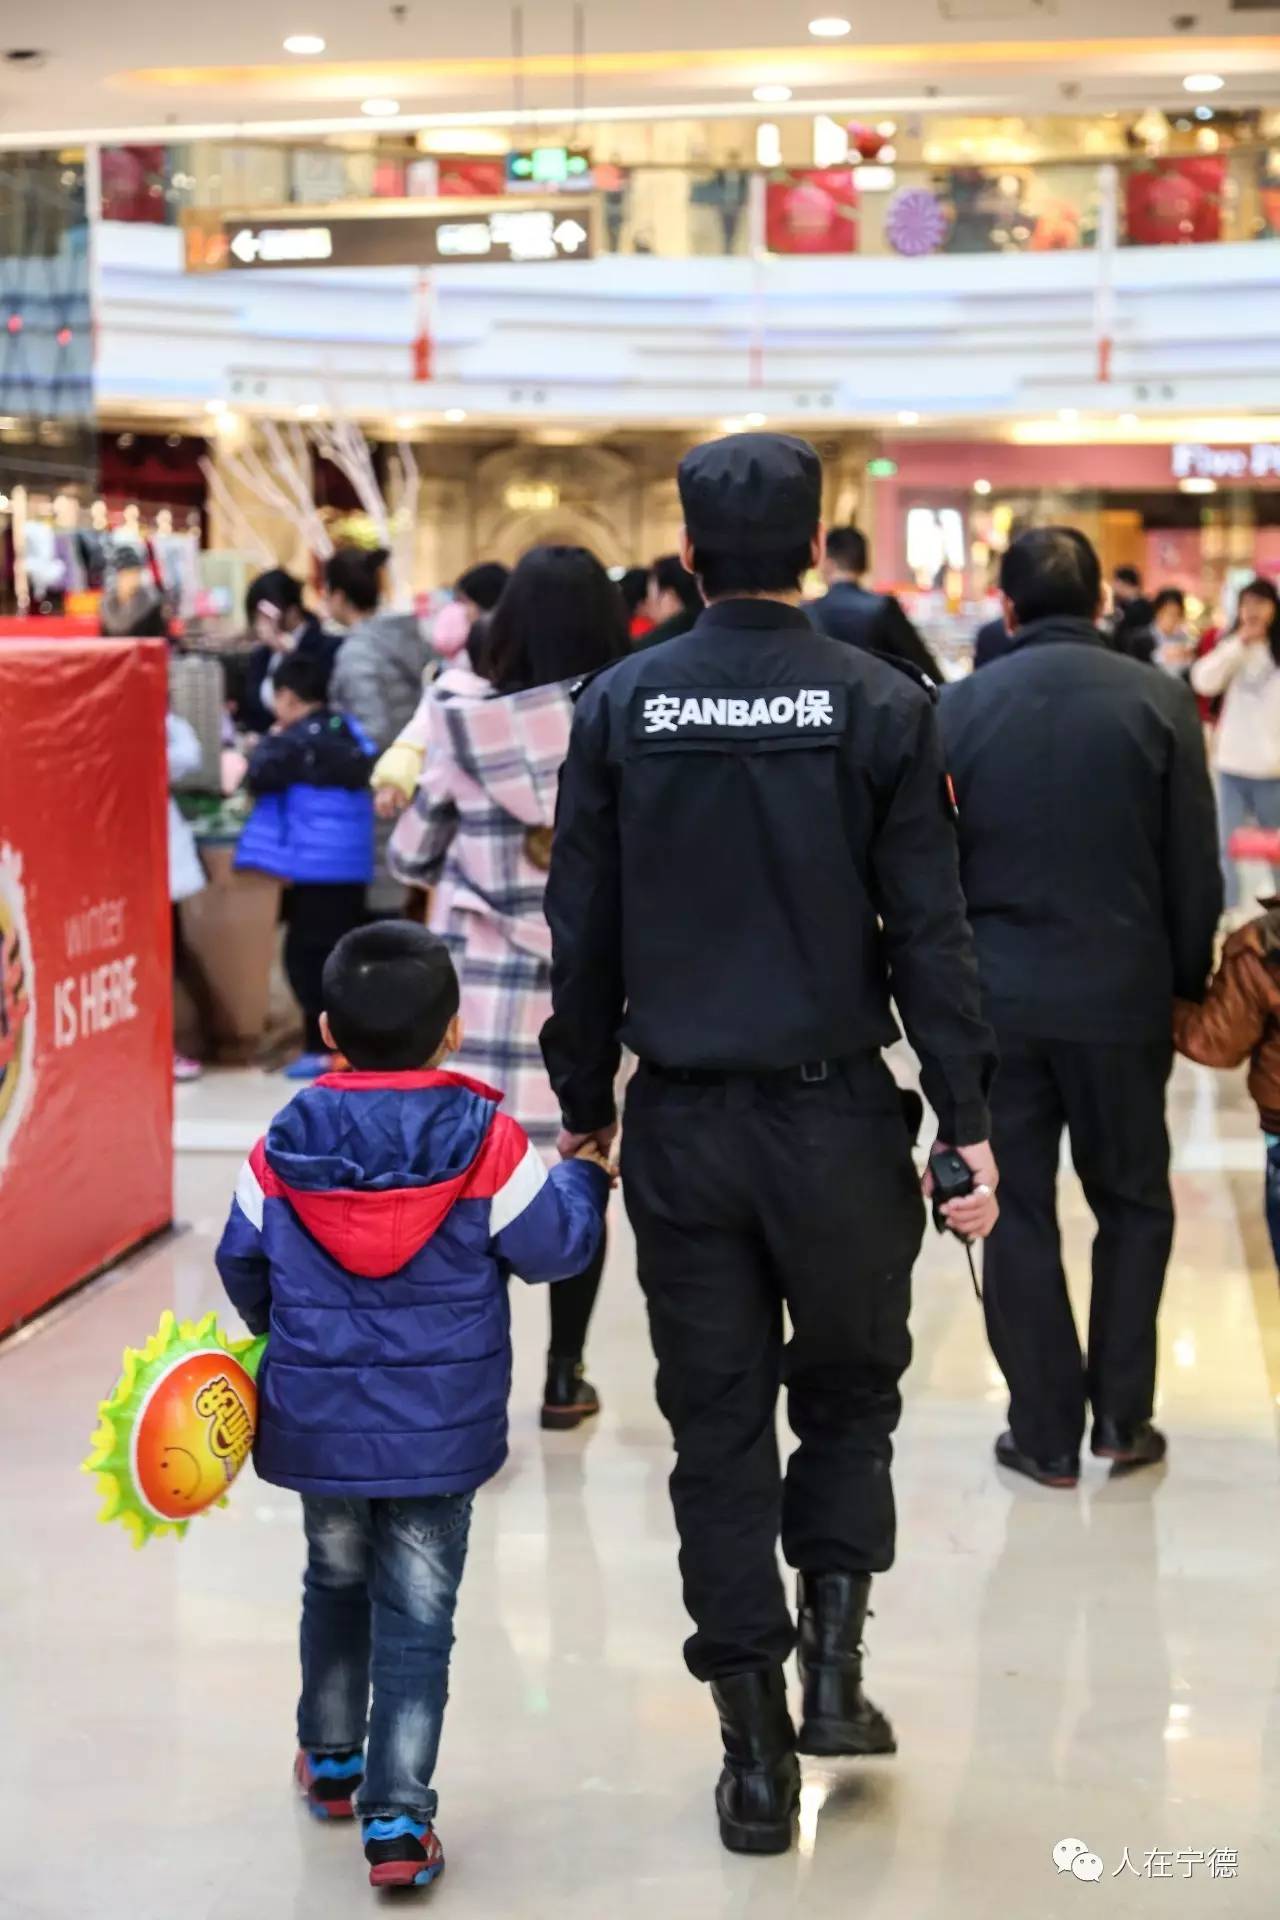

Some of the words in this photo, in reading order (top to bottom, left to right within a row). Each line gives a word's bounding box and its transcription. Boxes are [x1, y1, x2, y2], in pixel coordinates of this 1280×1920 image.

[643, 689, 833, 733] 安ANBAO保
[54, 976, 77, 1049] IS
[80, 954, 138, 1038] HERE
